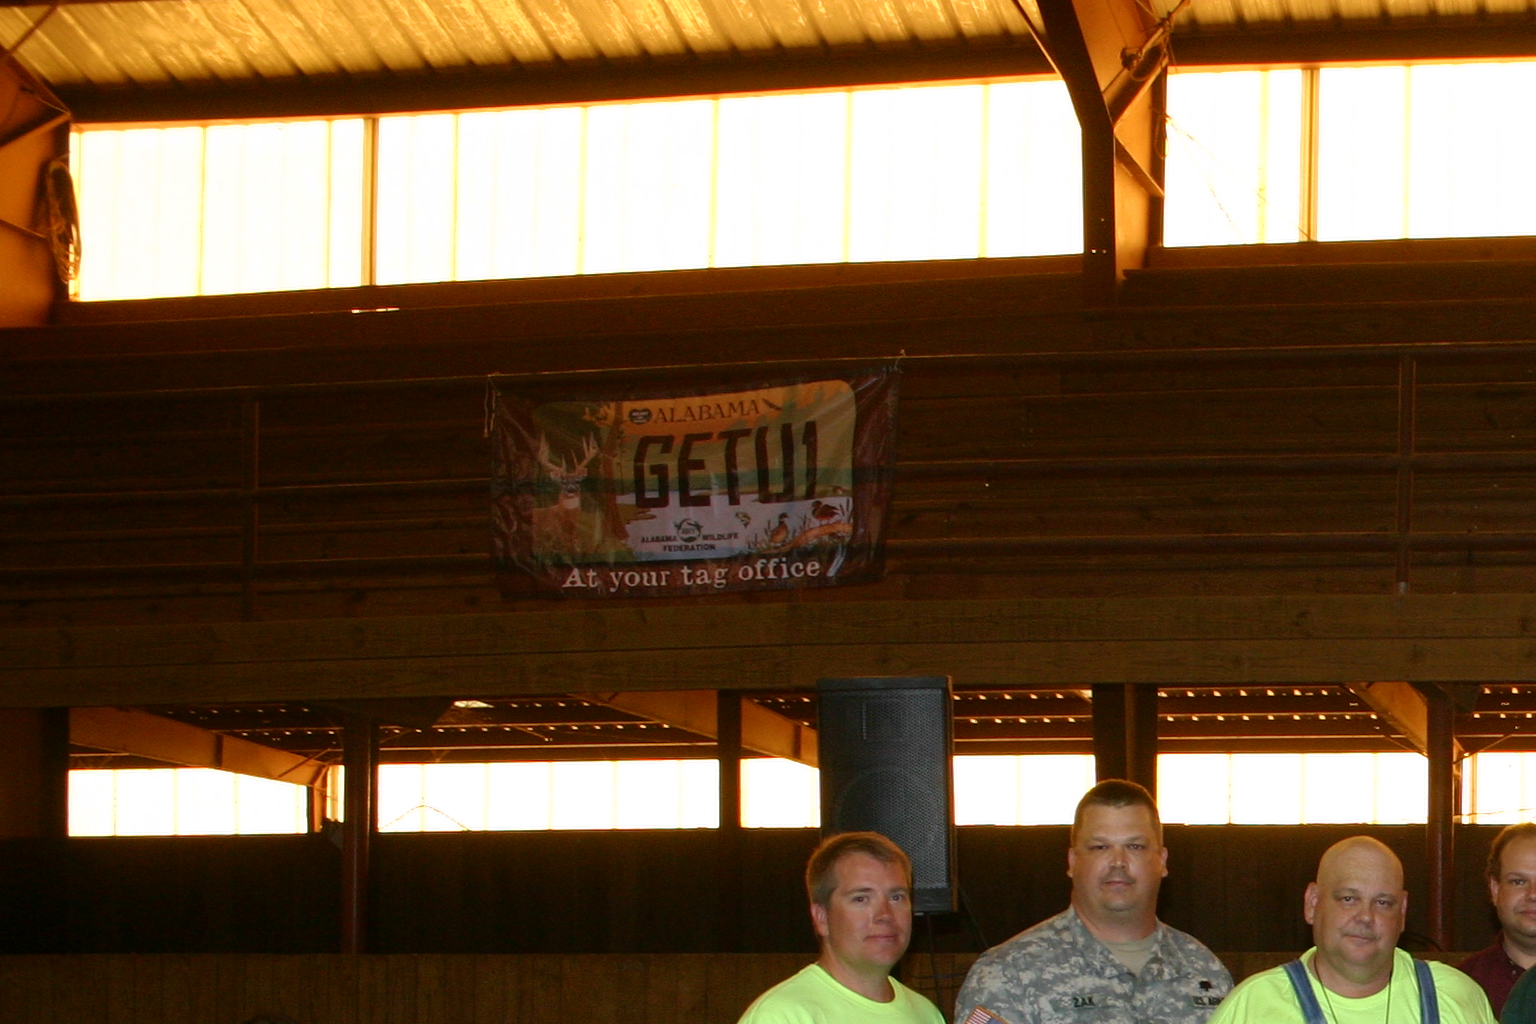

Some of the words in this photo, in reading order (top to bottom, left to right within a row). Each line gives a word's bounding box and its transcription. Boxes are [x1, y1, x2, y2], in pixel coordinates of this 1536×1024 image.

[653, 400, 760, 424] ALABAMA
[702, 533, 739, 541] WILDLIFE
[663, 544, 716, 552] FEDERATION
[563, 567, 599, 589] At
[609, 569, 671, 592] your
[683, 565, 727, 588] tag
[738, 557, 820, 580] office
